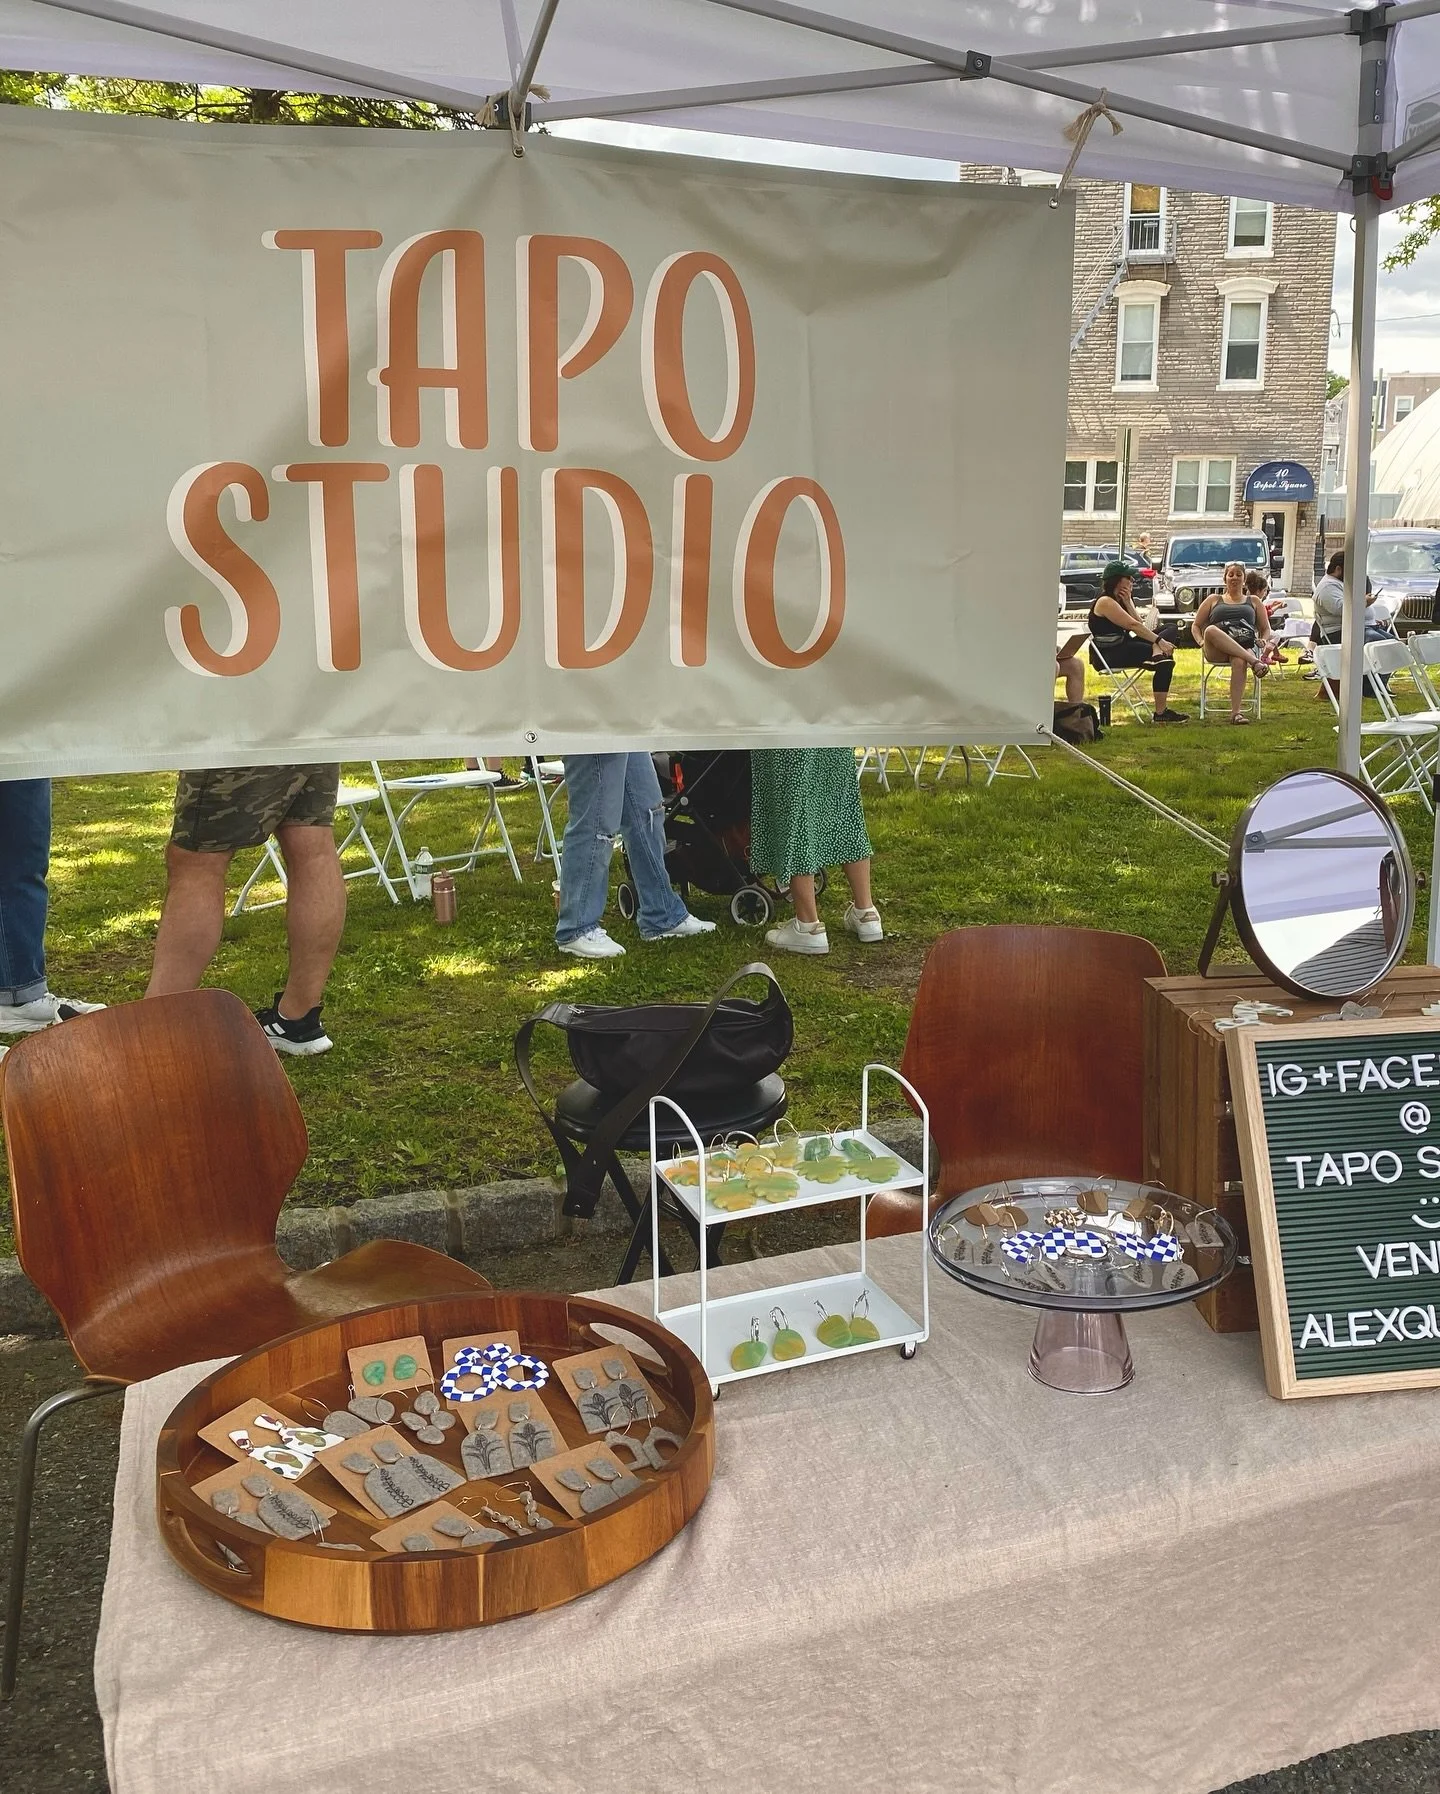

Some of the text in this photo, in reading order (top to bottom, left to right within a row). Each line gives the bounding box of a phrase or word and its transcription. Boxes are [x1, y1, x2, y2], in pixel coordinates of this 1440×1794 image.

[261, 229, 757, 463] TAPO
[1253, 480, 1308, 492] Depot Square
[1274, 468, 1289, 478] 10
[164, 460, 847, 677] STUDIO
[1266, 1053, 1440, 1098] IG+FACE
[1399, 1101, 1431, 1135] @
[1285, 1150, 1403, 1190] TAPO
[1355, 1239, 1440, 1280] VEN
